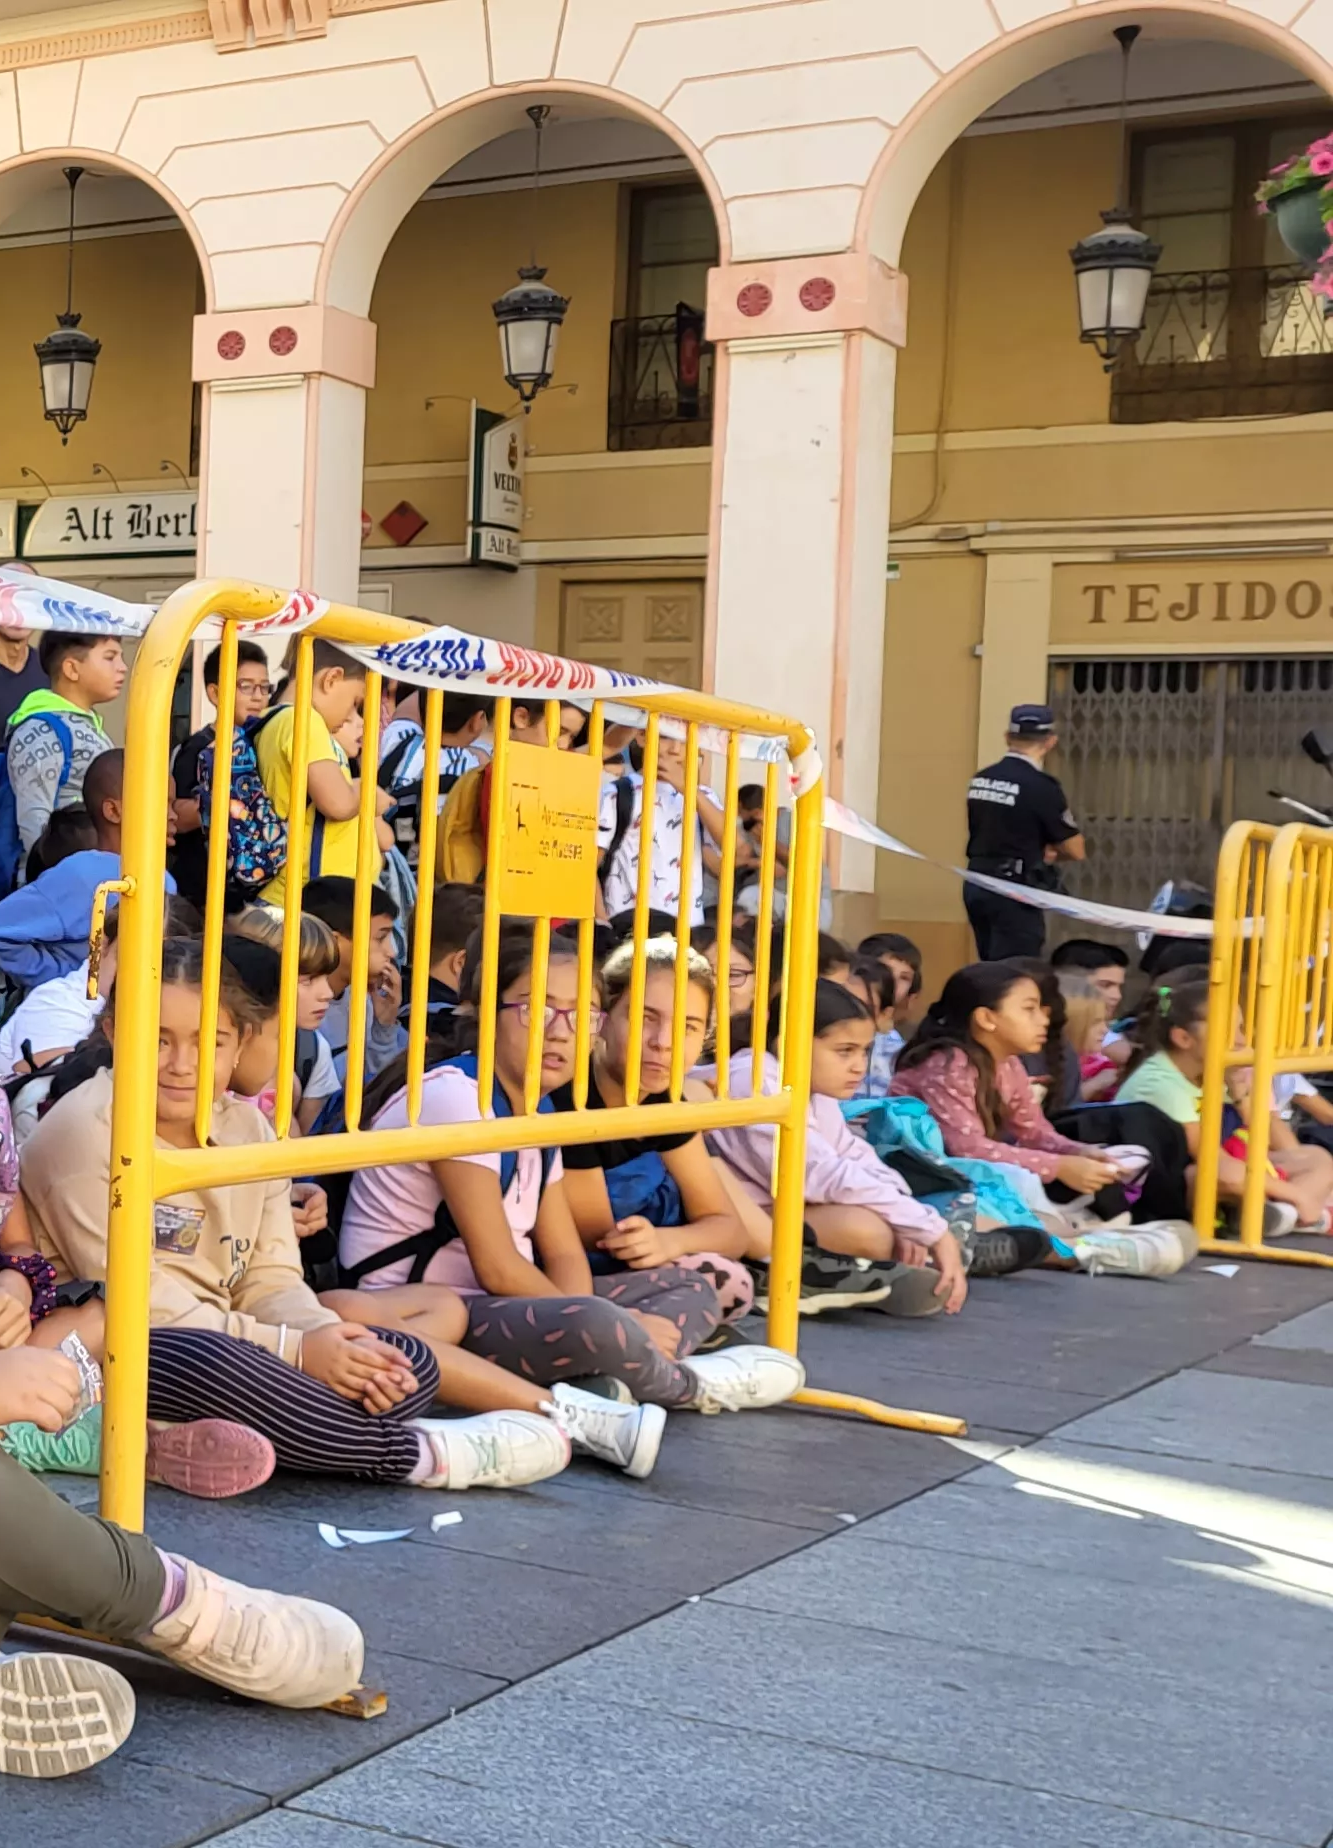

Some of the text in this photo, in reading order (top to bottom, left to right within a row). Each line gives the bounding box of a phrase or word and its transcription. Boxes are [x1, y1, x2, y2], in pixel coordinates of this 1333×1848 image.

[60, 502, 198, 542] Alt Berl
[1082, 580, 1333, 624] TEJIDO
